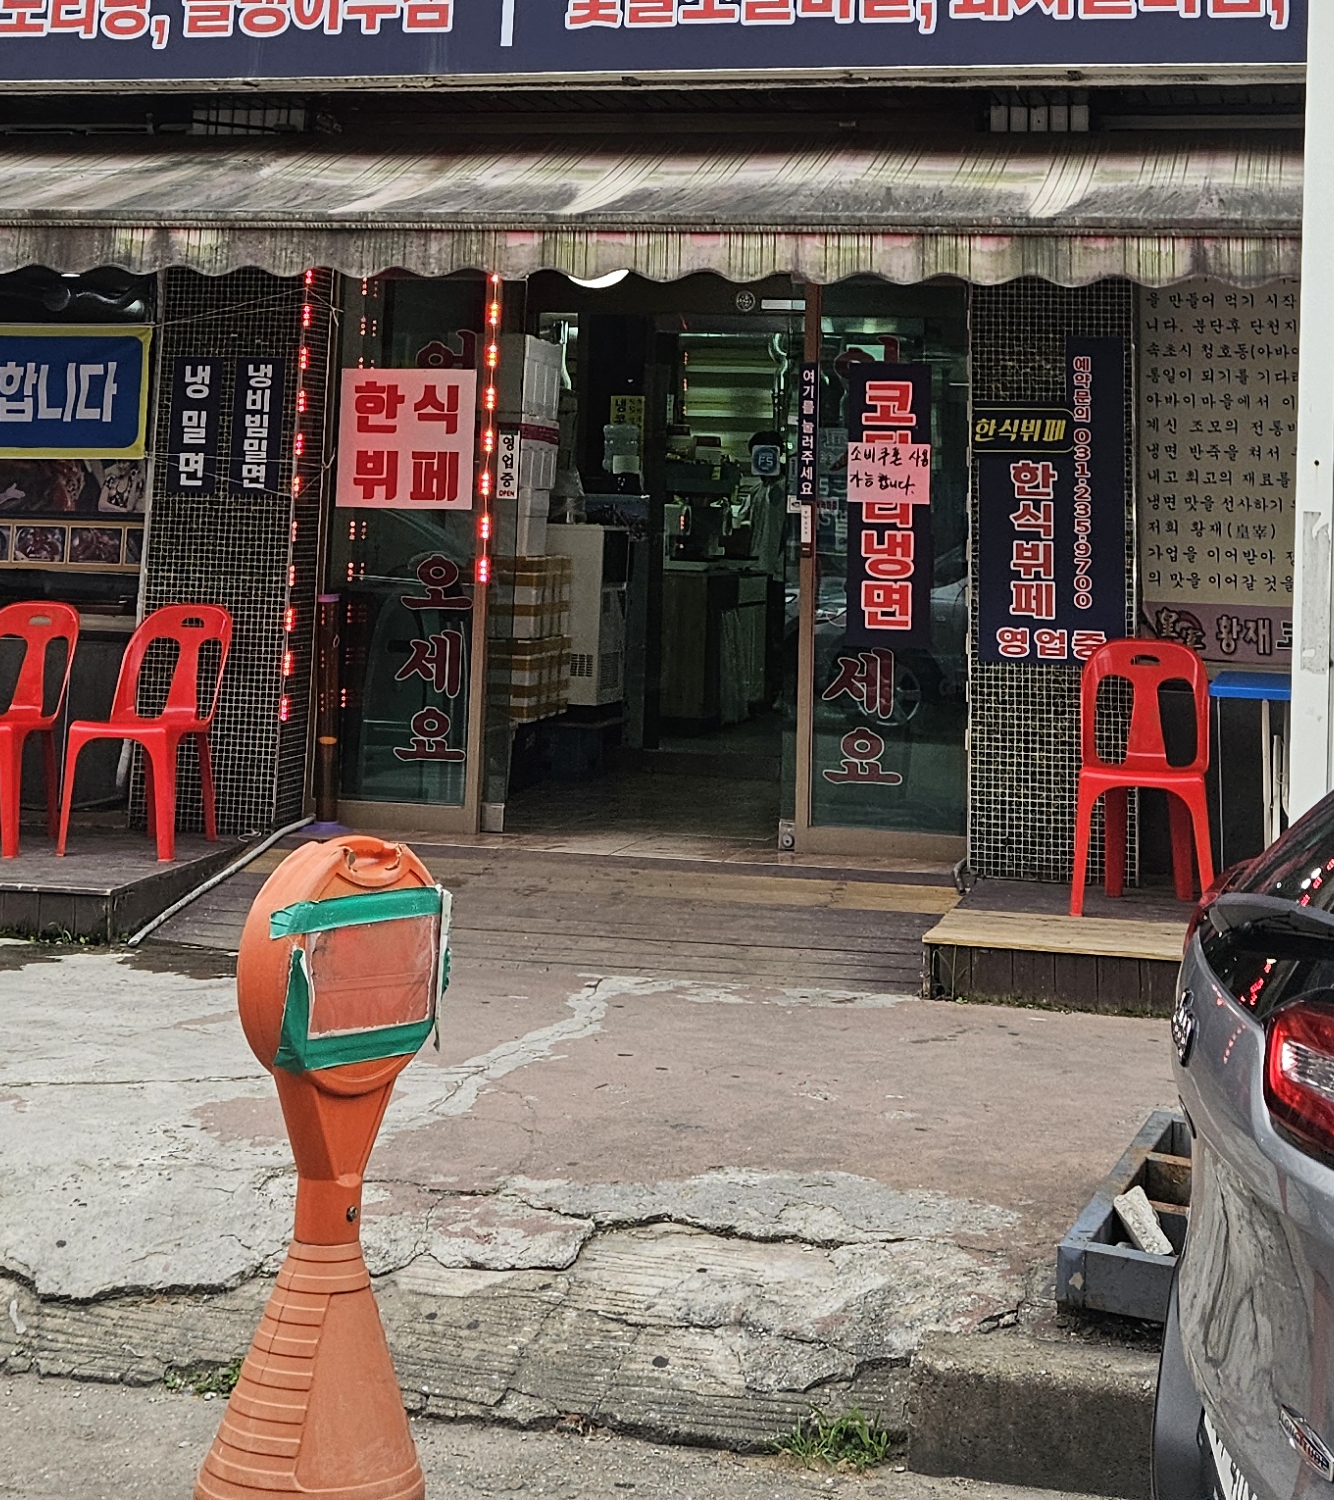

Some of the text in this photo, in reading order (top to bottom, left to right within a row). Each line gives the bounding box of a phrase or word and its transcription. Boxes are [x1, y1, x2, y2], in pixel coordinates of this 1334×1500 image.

[1169, 292, 1215, 309] 만들어
[1224, 293, 1255, 309] 먹기
[1192, 318, 1241, 334] 분단후
[1146, 342, 1192, 358] 속초시
[1146, 367, 1192, 384] 통일이
[1201, 368, 1249, 385] 되기를
[1073, 356, 1092, 423] 예약문의
[354, 380, 460, 435] 한식
[241, 364, 273, 489] 냉비빔밀면
[974, 417, 1067, 443] 한식뷔페
[1189, 419, 1239, 435] 조모의
[500, 435, 515, 488] 영업중
[850, 446, 929, 468] 소비쿠폰 사용
[1146, 443, 1178, 460] 냉면
[1189, 443, 1239, 461] 반죽을
[352, 449, 459, 502] 뷔페
[1185, 469, 1233, 486] 최고의
[498, 489, 515, 497] OPEN
[1146, 493, 1284, 513] 냉면 맛을 선사하기
[1009, 460, 1058, 620] 한식뷔페
[1148, 545, 1198, 563] 가업을
[1207, 548, 1276, 565] 이어받아
[1170, 571, 1201, 589] 맛을
[1208, 573, 1257, 591] 이어갈
